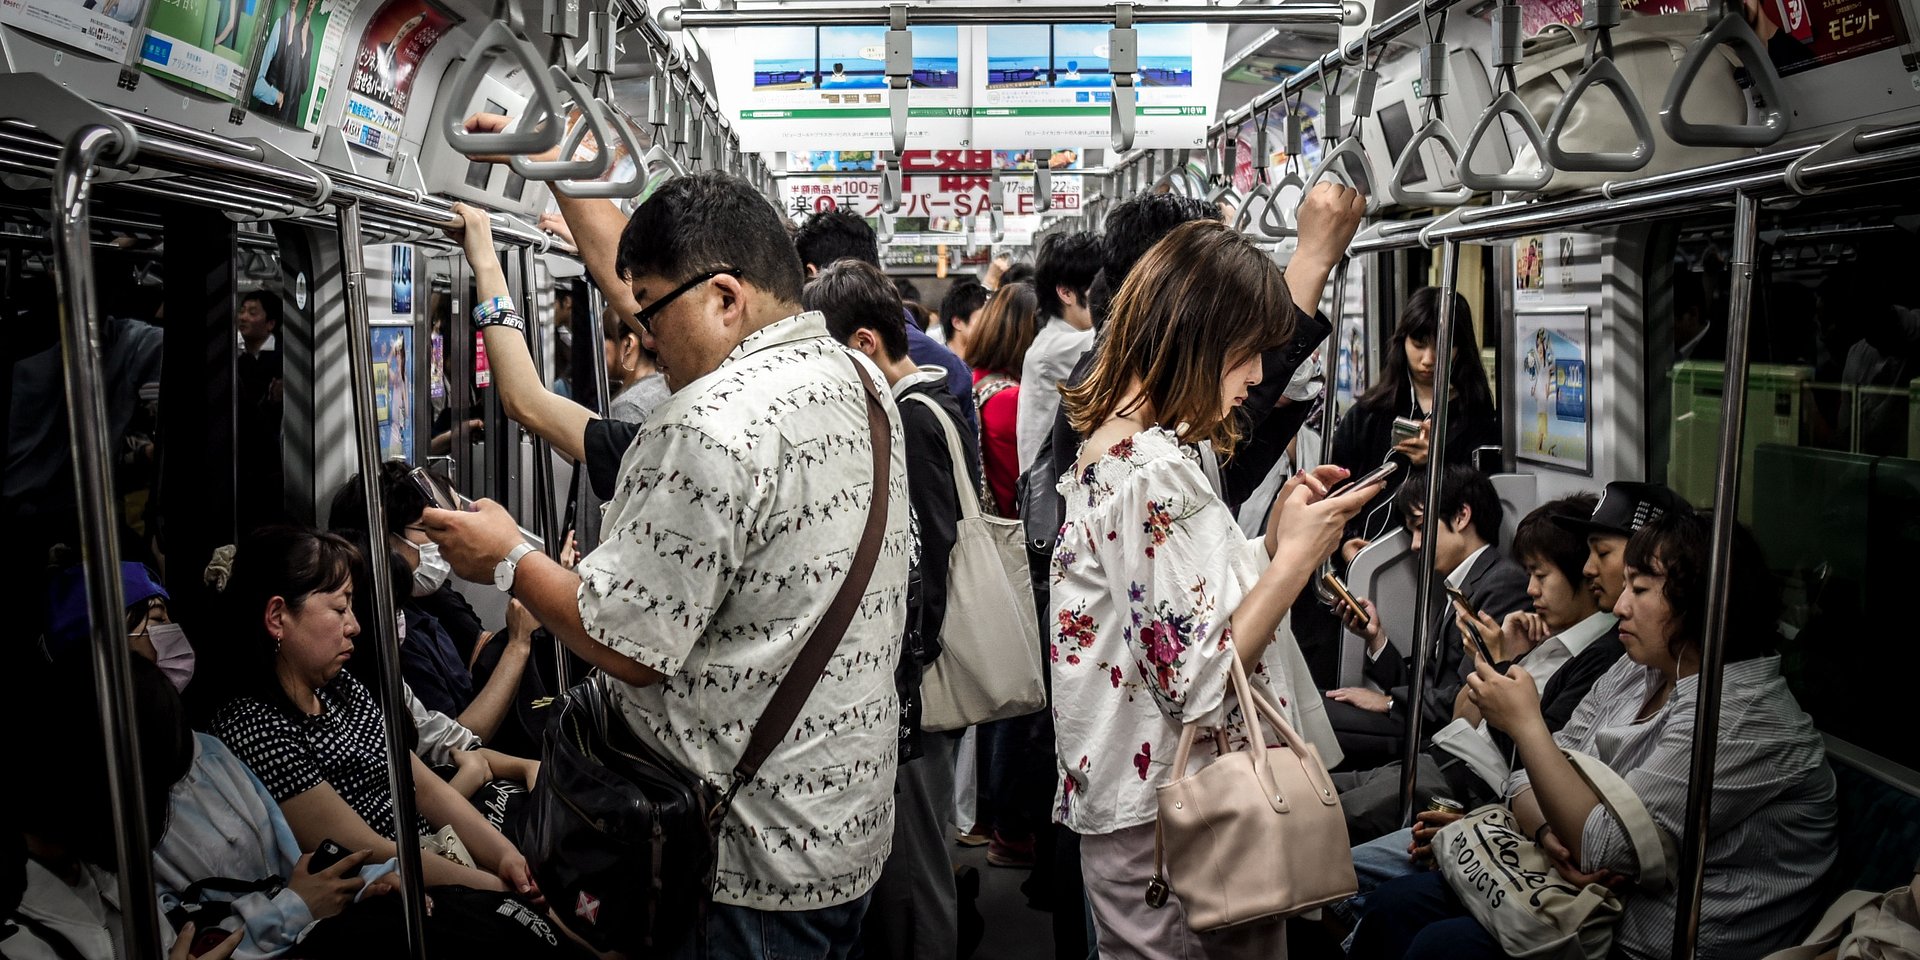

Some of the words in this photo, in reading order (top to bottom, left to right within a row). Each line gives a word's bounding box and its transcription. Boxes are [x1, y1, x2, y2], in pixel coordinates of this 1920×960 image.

[1828, 8, 1880, 41] モビット
[1451, 831, 1506, 909] PRODUCTS
